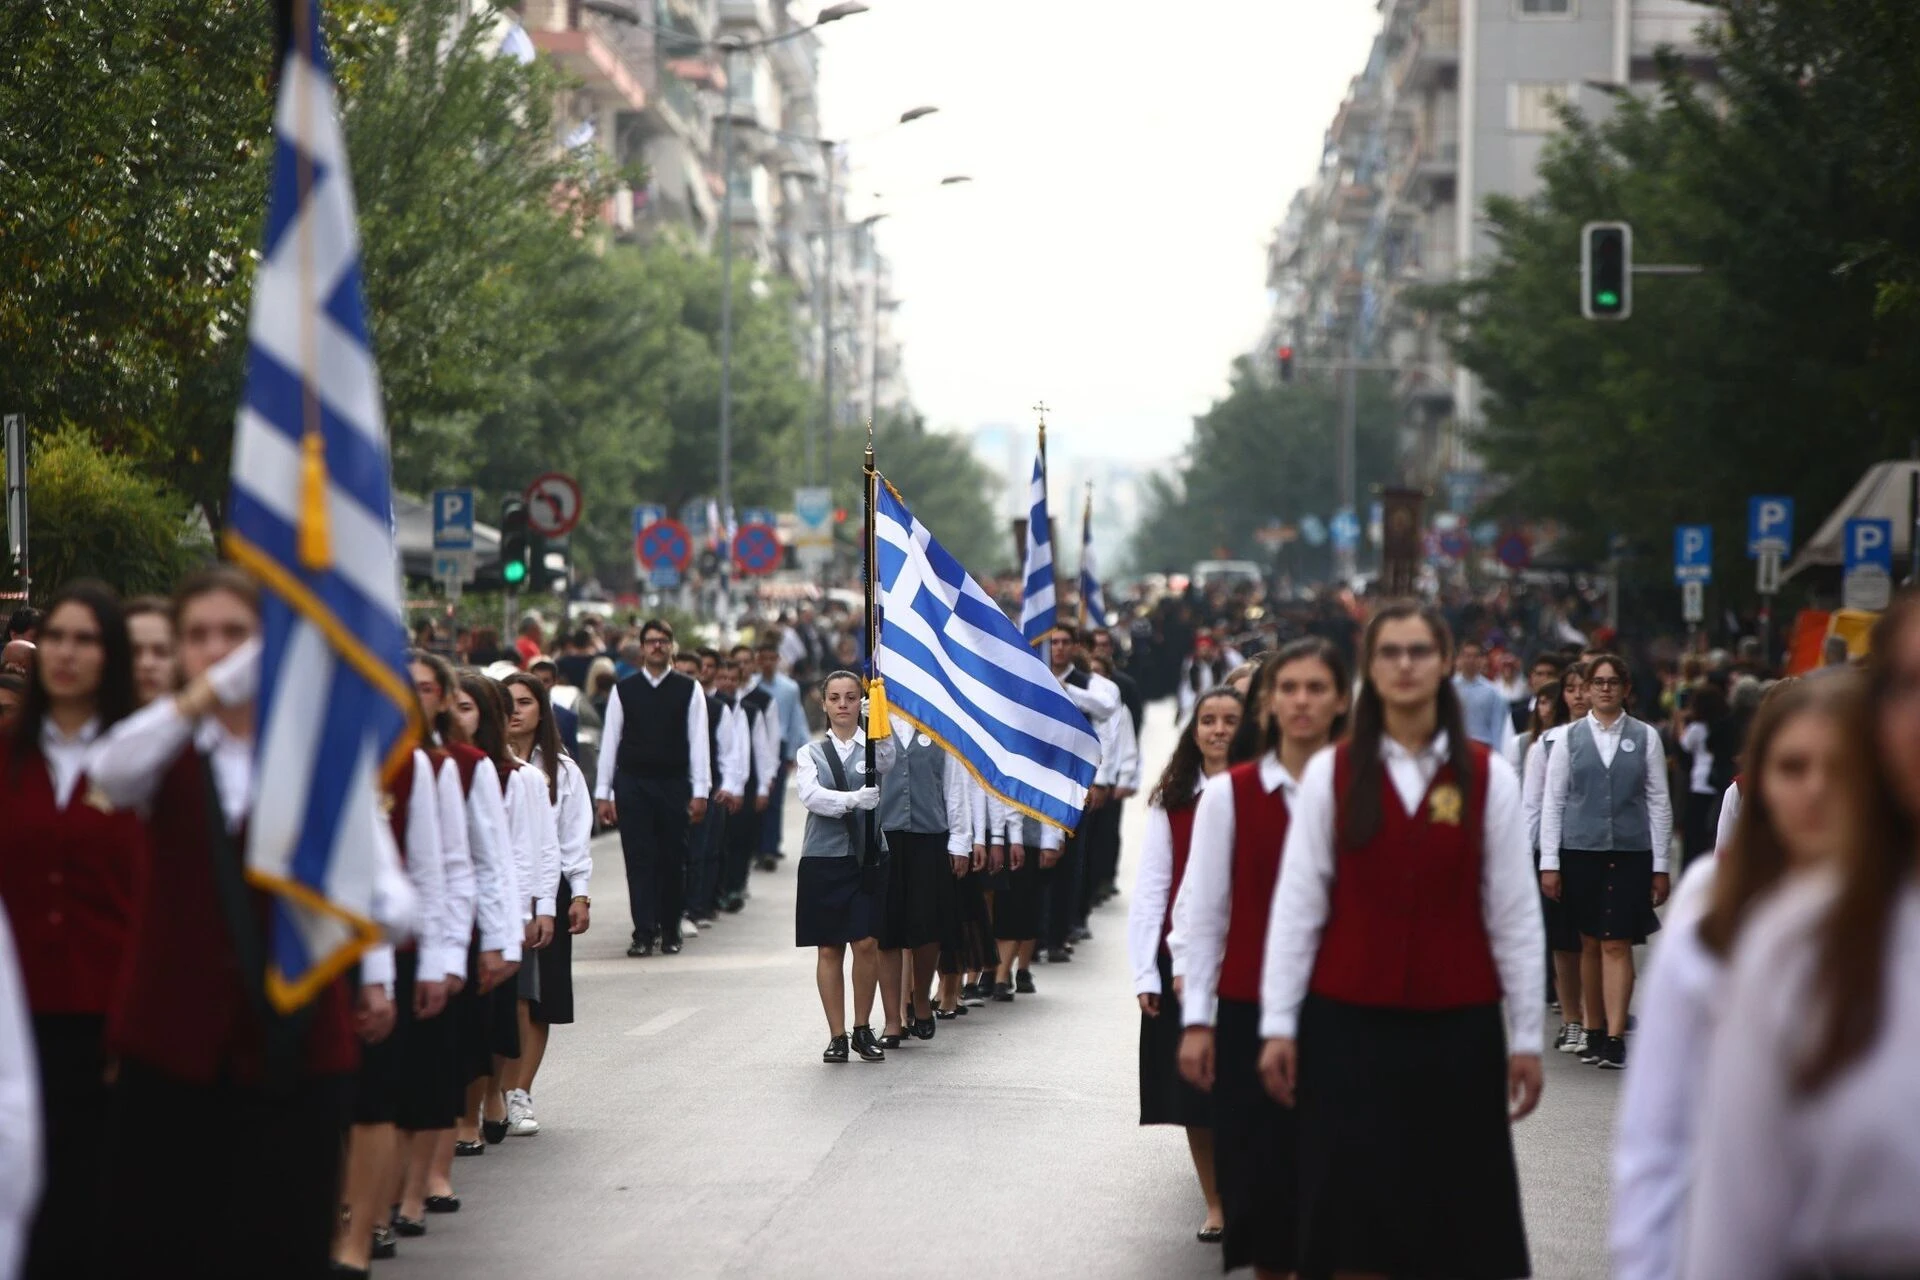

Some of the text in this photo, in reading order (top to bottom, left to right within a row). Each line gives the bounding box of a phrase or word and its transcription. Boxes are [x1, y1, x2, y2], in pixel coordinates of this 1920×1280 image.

[444, 495, 463, 521] P
[1759, 501, 1784, 532] P
[1684, 528, 1703, 560] P
[1855, 525, 1883, 558] P
